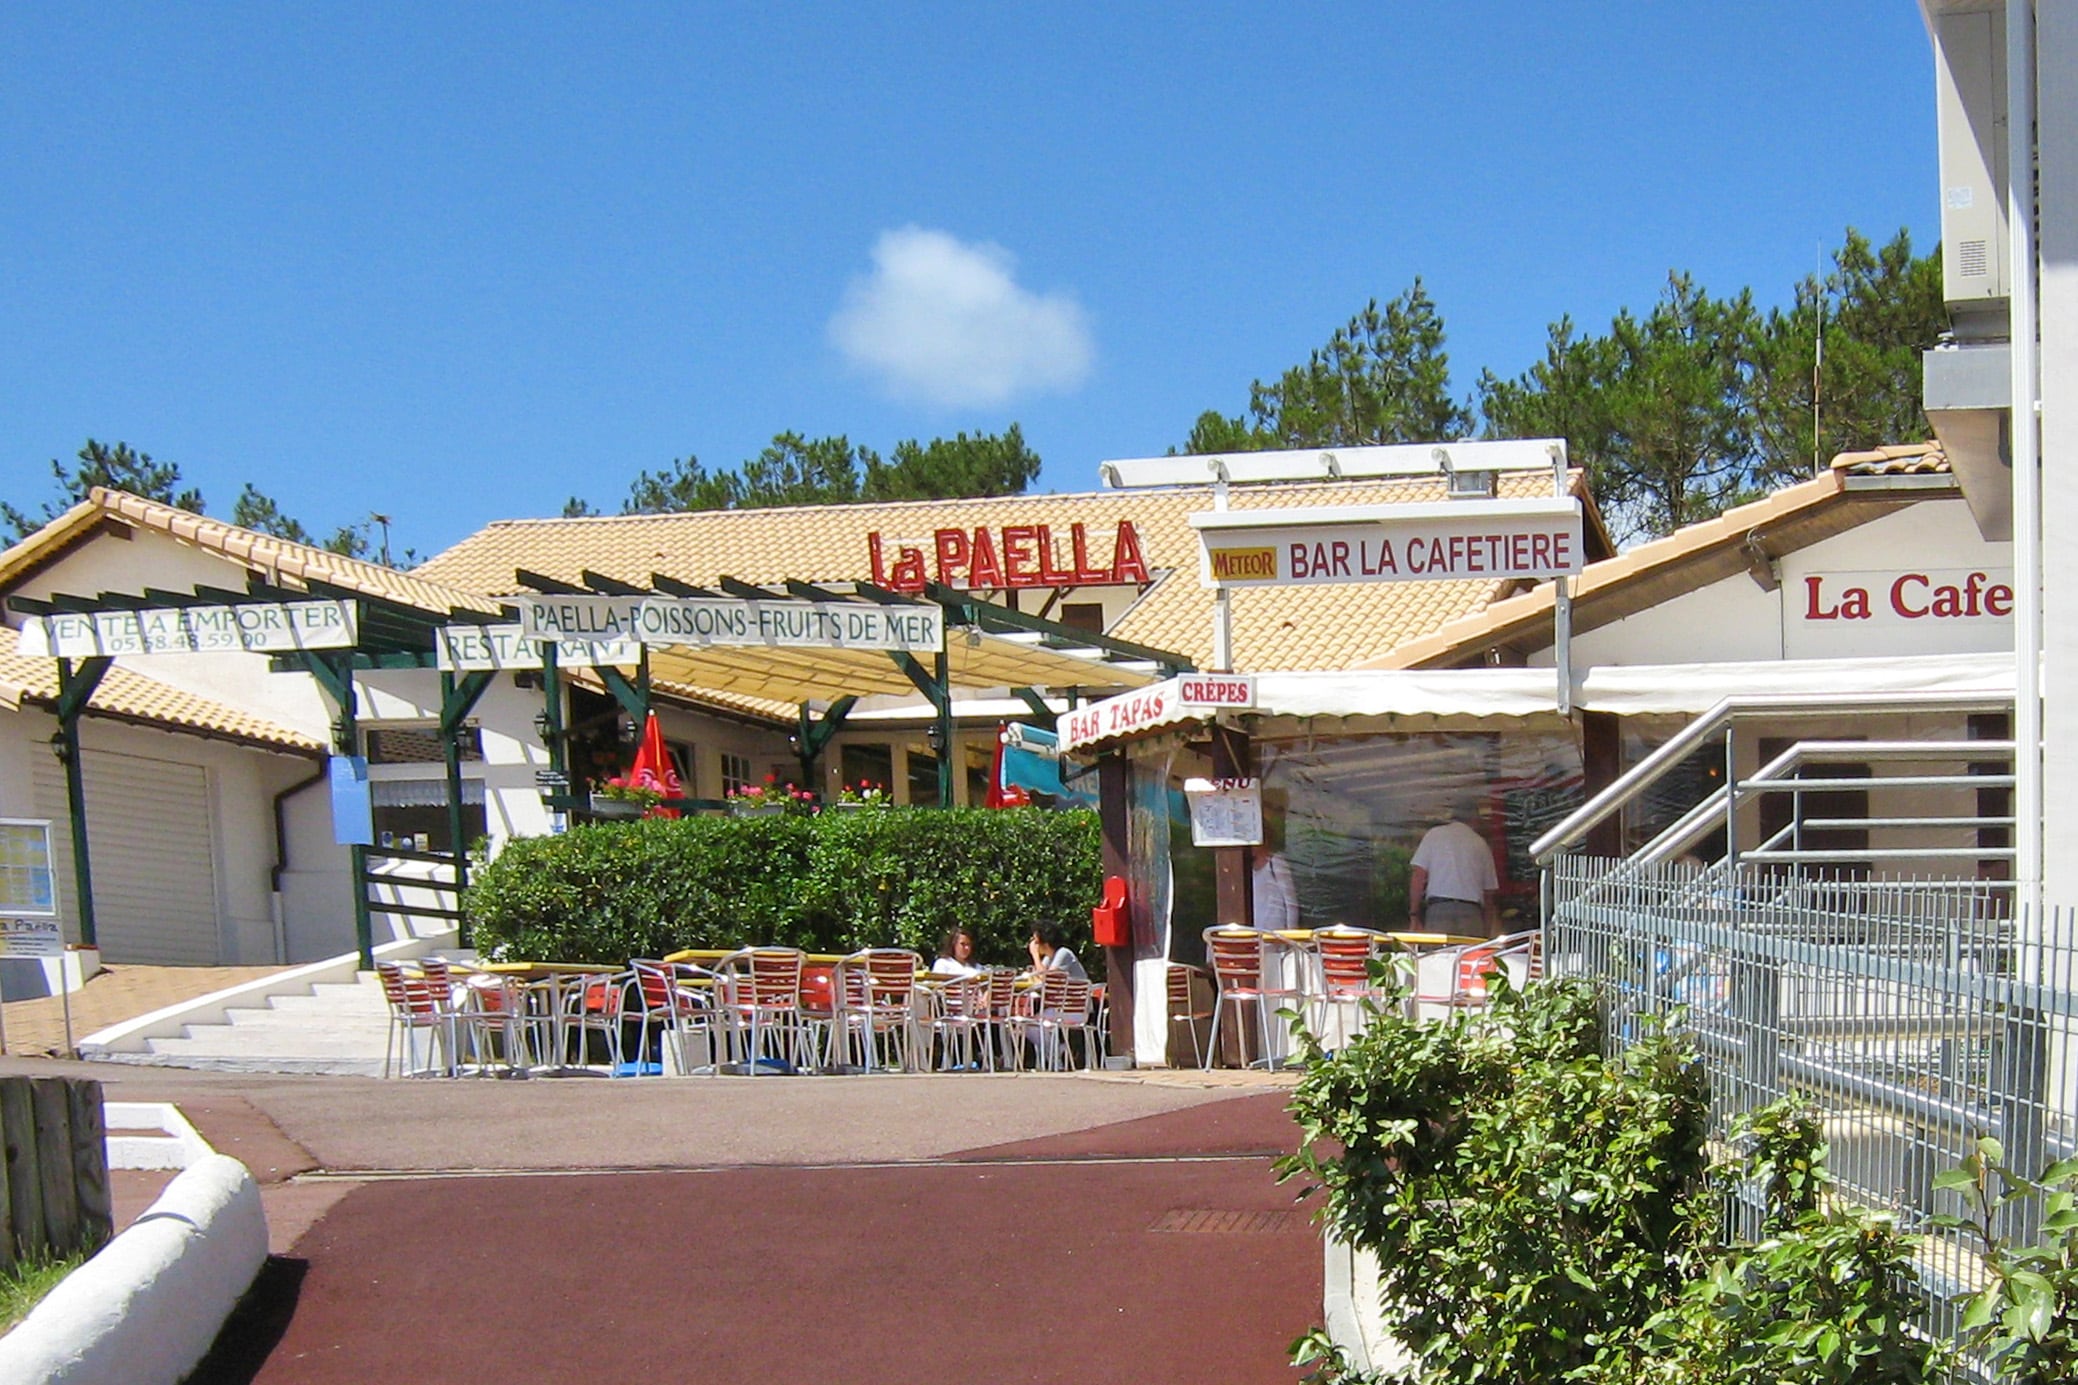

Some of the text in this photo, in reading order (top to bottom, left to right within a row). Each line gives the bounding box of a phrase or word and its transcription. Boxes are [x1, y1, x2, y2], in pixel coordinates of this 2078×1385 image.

[867, 520, 1151, 593] La PAELLA
[1213, 551, 1276, 578] METEOR
[1289, 532, 1571, 580] BAR LA CAFETIERE
[1804, 576, 1872, 620] La
[47, 605, 342, 640] VENTE A EMPORTER
[849, 612, 877, 641] DE
[884, 614, 935, 644] MER
[1182, 677, 1248, 703] CRÊPES
[1069, 691, 1165, 743] BAR TAPAS
